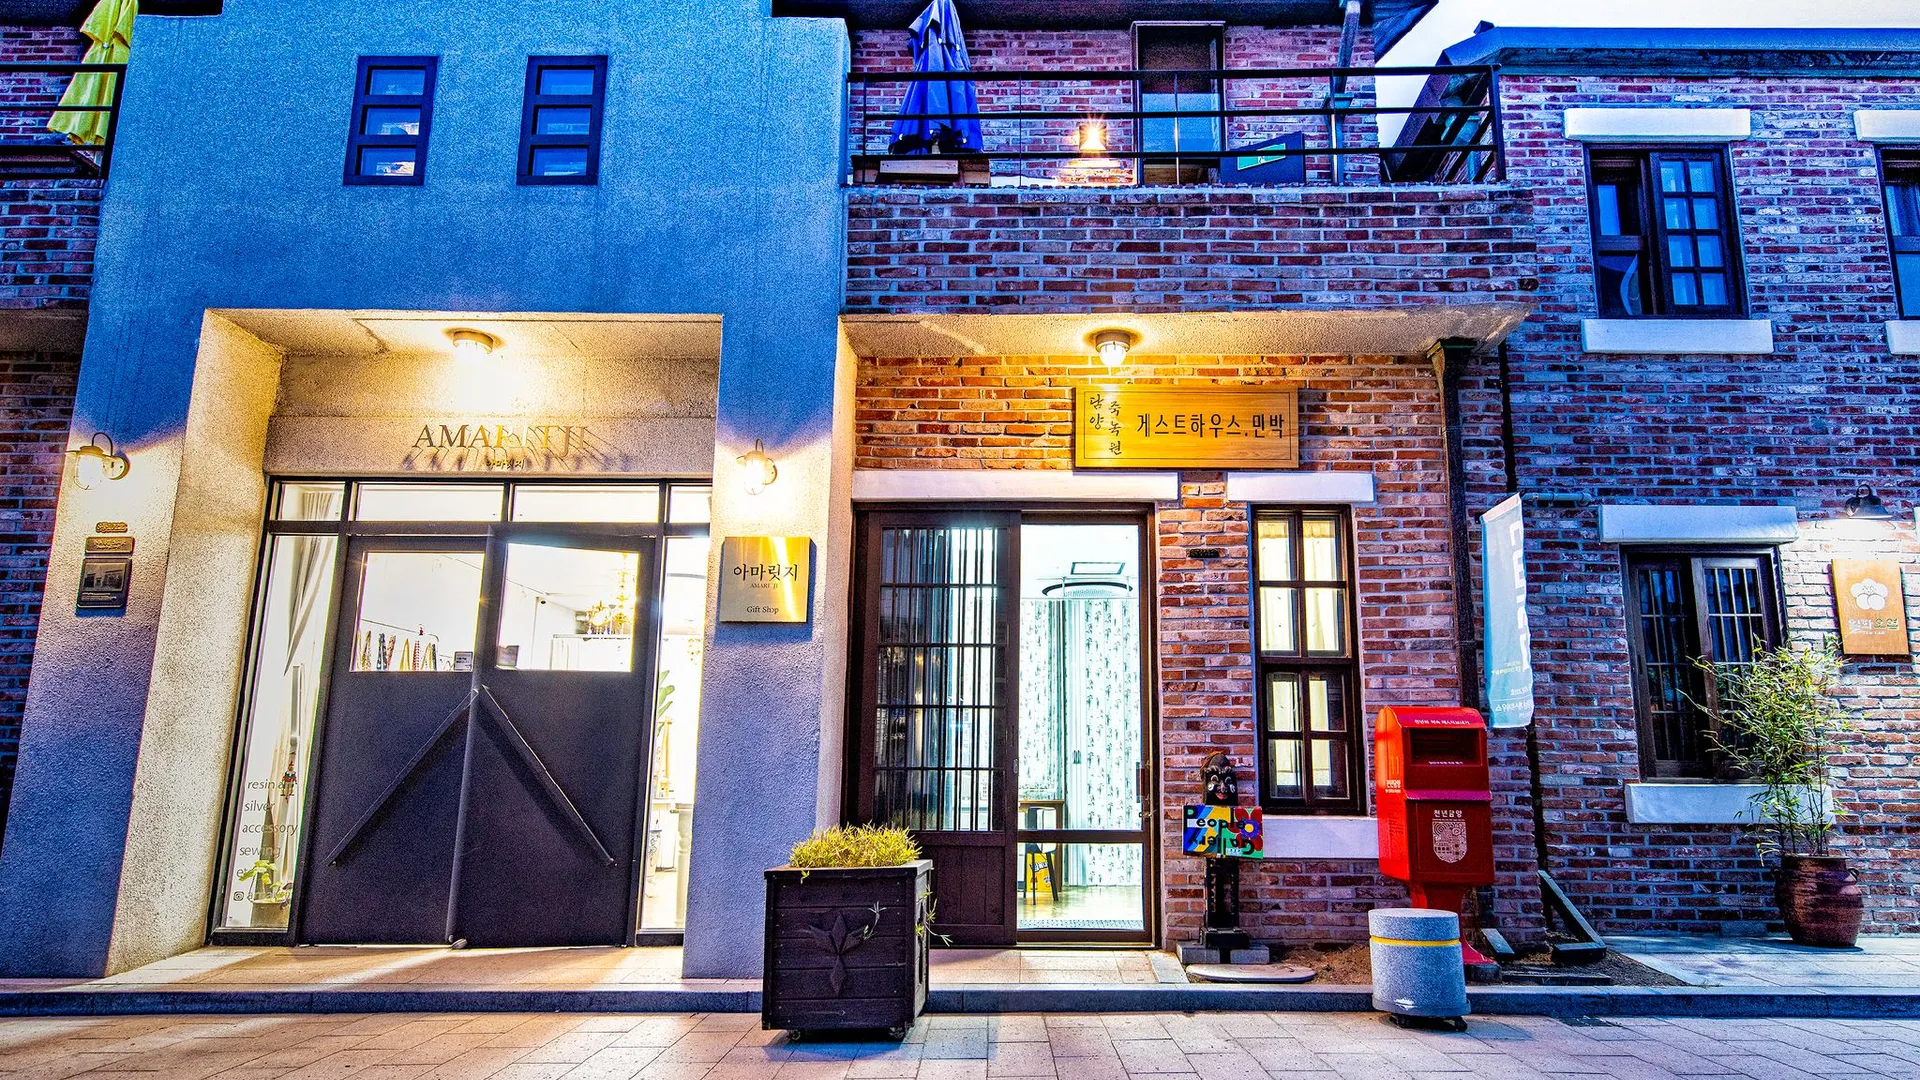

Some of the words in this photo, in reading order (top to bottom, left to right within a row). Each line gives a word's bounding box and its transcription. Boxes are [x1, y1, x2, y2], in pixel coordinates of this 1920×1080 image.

[733, 563, 798, 581] 아마릿지
[762, 606, 780, 615] Shop
[247, 779, 276, 790] resin
[244, 800, 276, 812] silver
[242, 822, 299, 836] accessory
